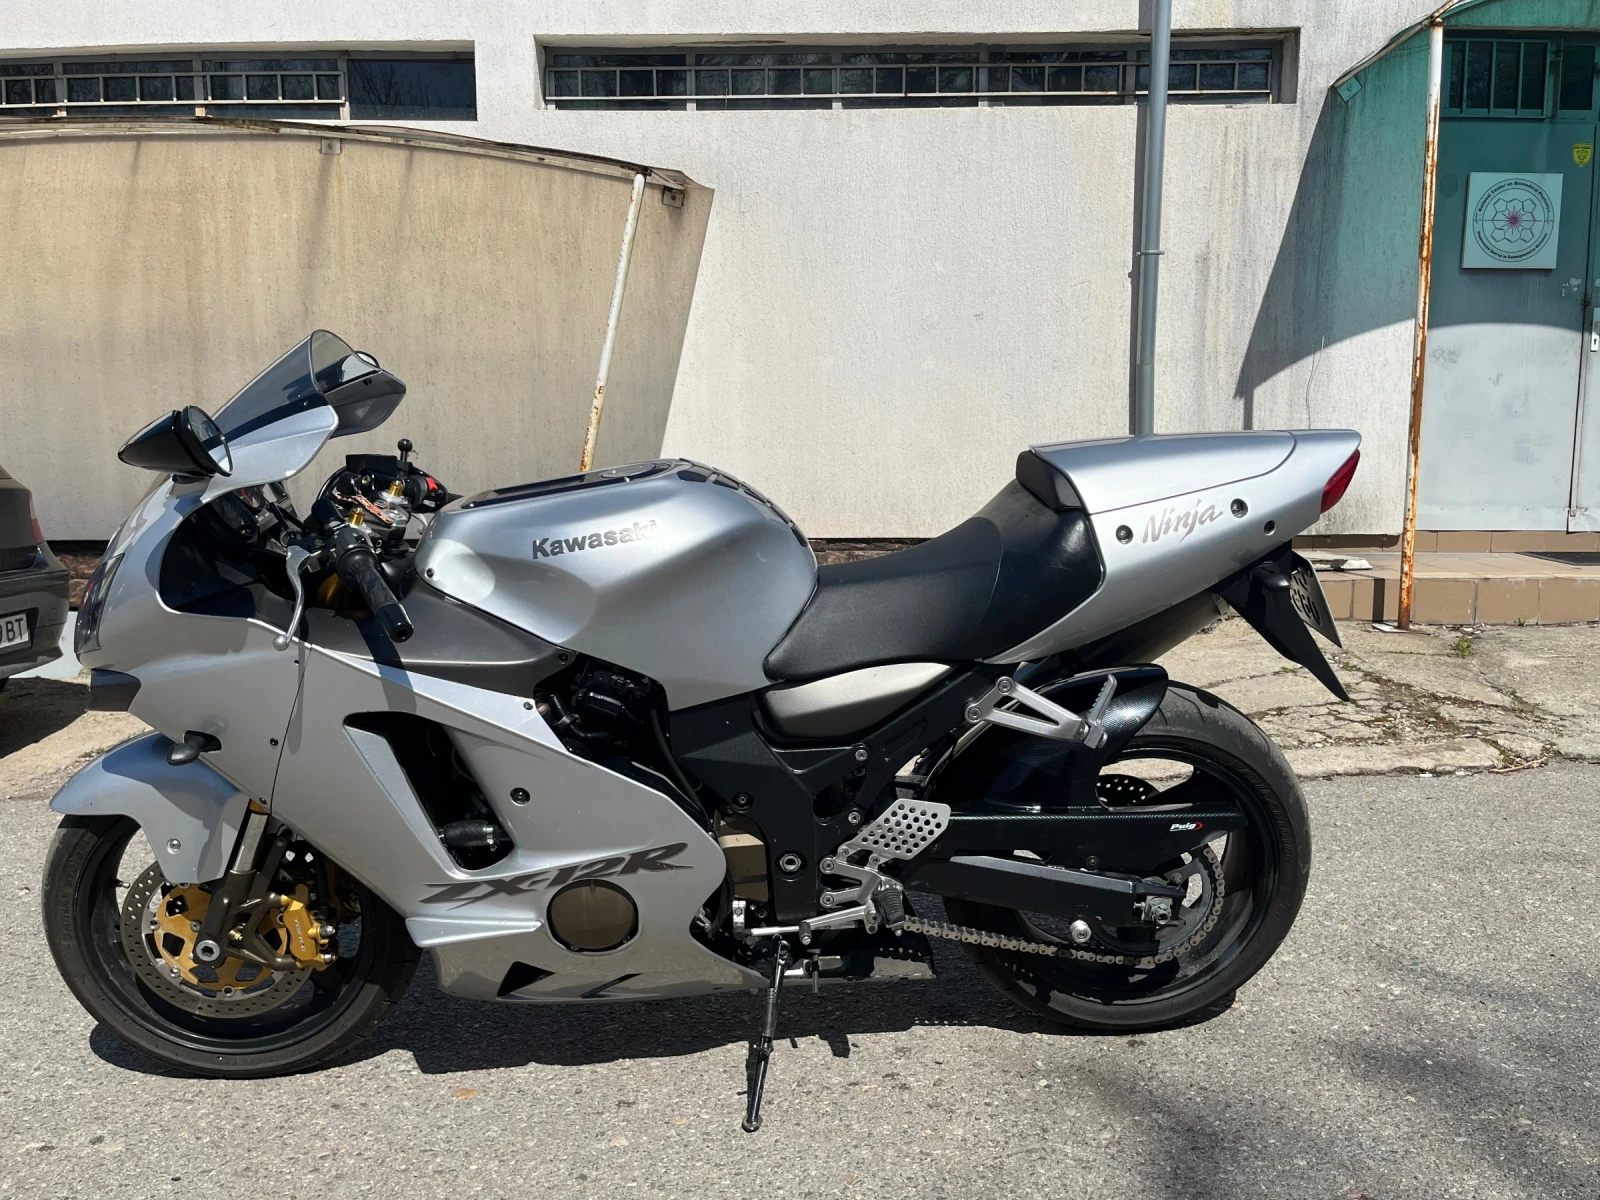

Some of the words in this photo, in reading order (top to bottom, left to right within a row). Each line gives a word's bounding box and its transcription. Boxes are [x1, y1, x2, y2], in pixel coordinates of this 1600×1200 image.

[532, 519, 658, 560] Kawasaki
[1142, 498, 1224, 543] Ninja
[0, 617, 24, 645] BT
[1170, 822, 1197, 830] Puig
[418, 842, 694, 911] ZX-12R
